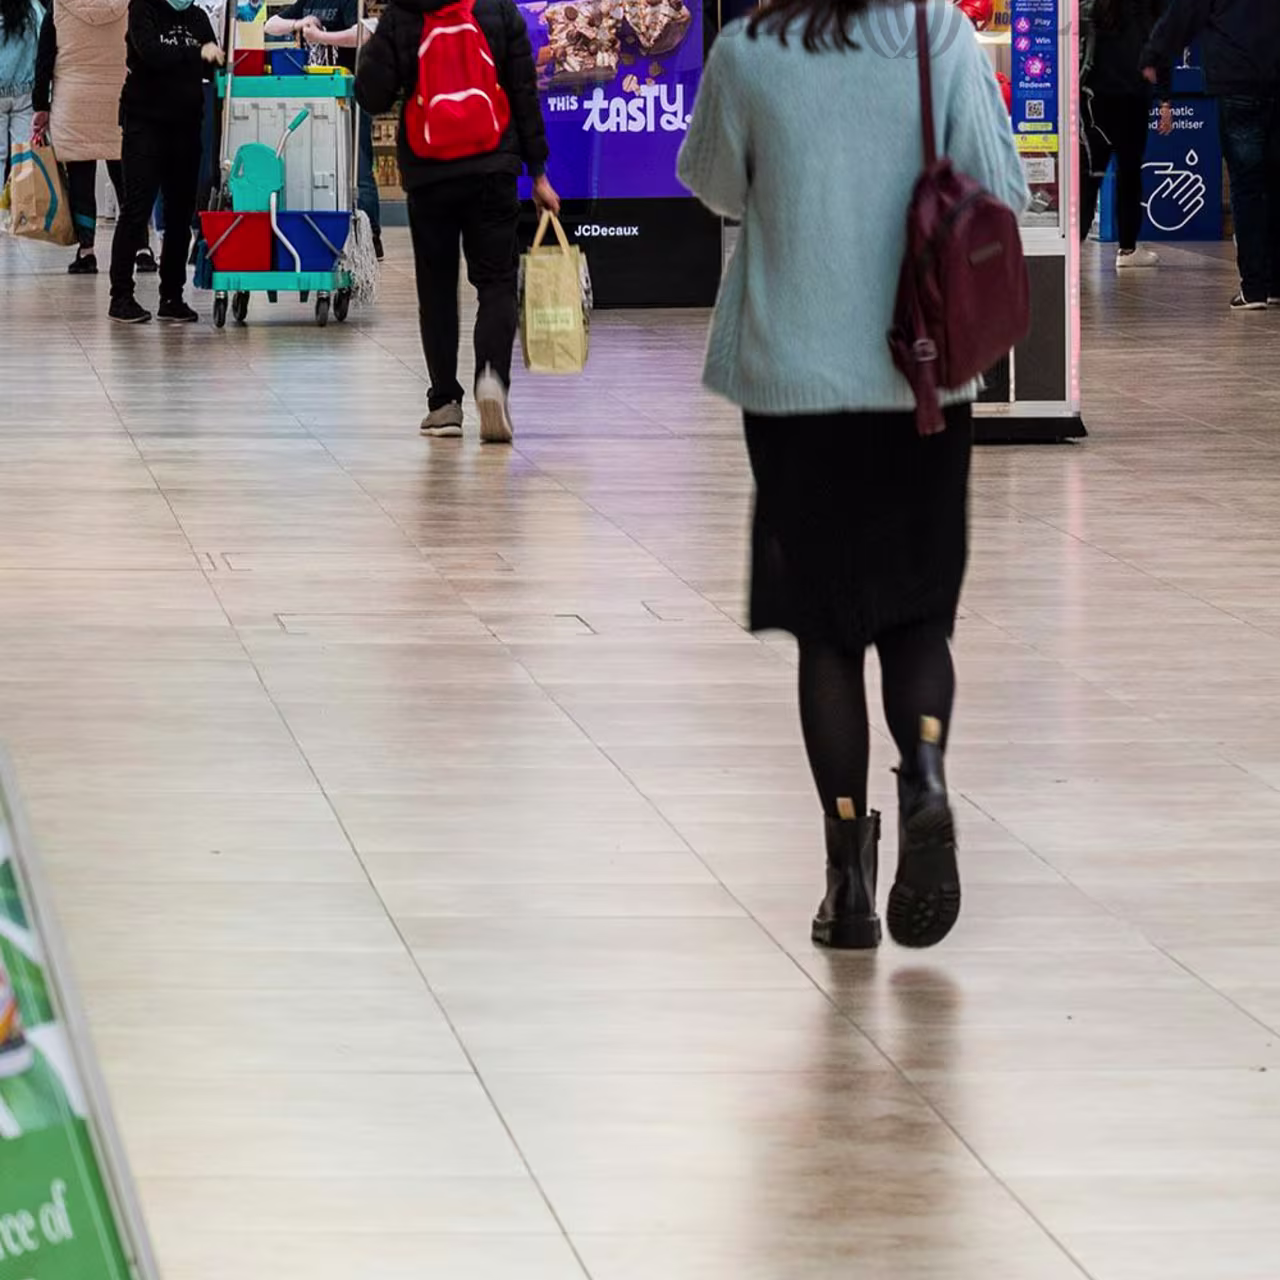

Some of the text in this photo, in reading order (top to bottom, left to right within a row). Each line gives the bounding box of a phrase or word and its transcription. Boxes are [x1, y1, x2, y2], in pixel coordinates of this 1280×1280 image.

[1035, 36, 1051, 45] Win
[1019, 80, 1052, 89] Redeem
[574, 224, 639, 237] JCDecaux
